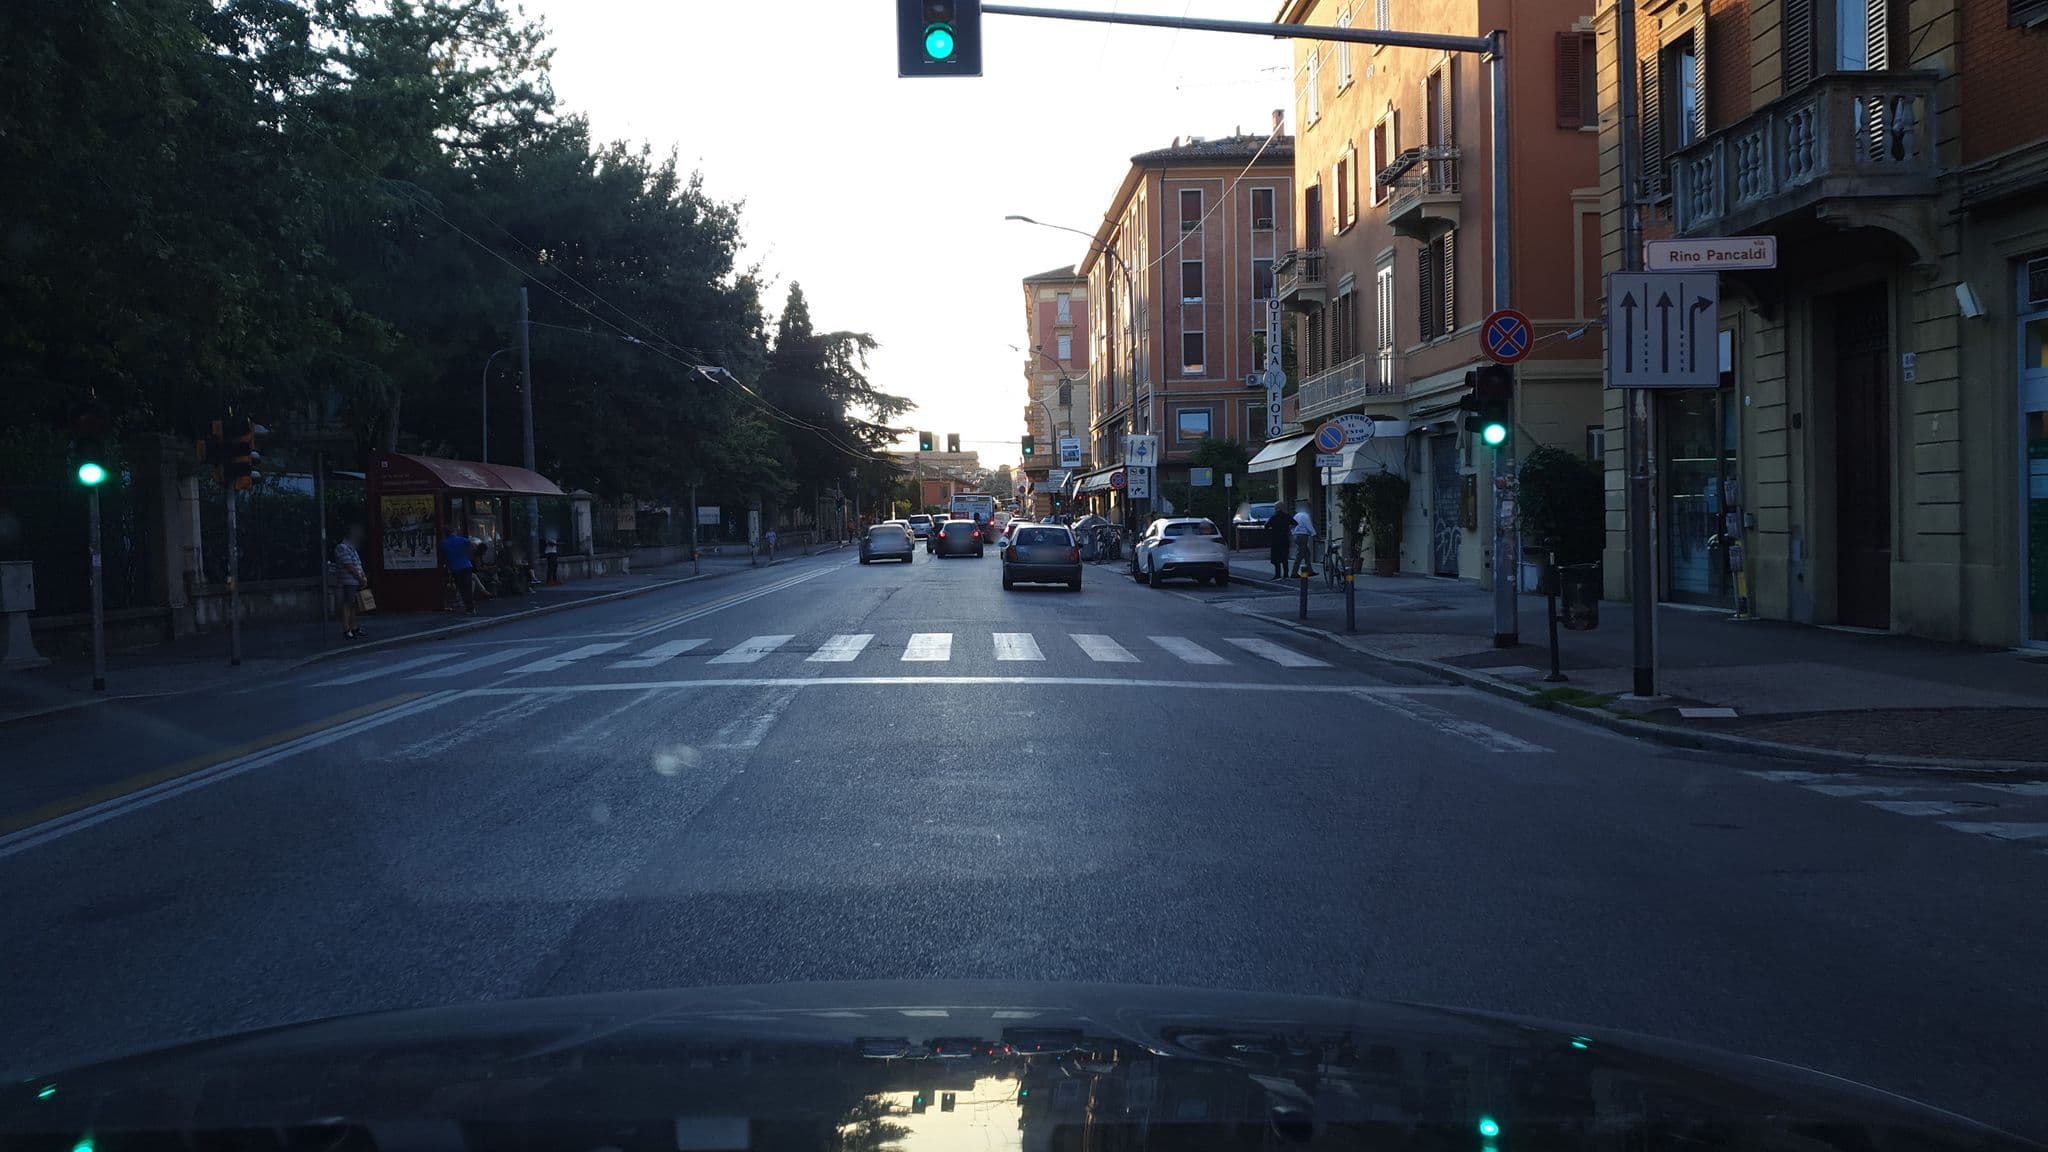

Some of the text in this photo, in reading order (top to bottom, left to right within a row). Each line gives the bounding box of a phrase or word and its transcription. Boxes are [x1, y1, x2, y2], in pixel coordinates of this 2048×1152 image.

[1670, 248, 1766, 262] Rino Pancaldi
[1269, 299, 1281, 436] OTTICA FOTO
[1334, 415, 1372, 427] RATTORIA
